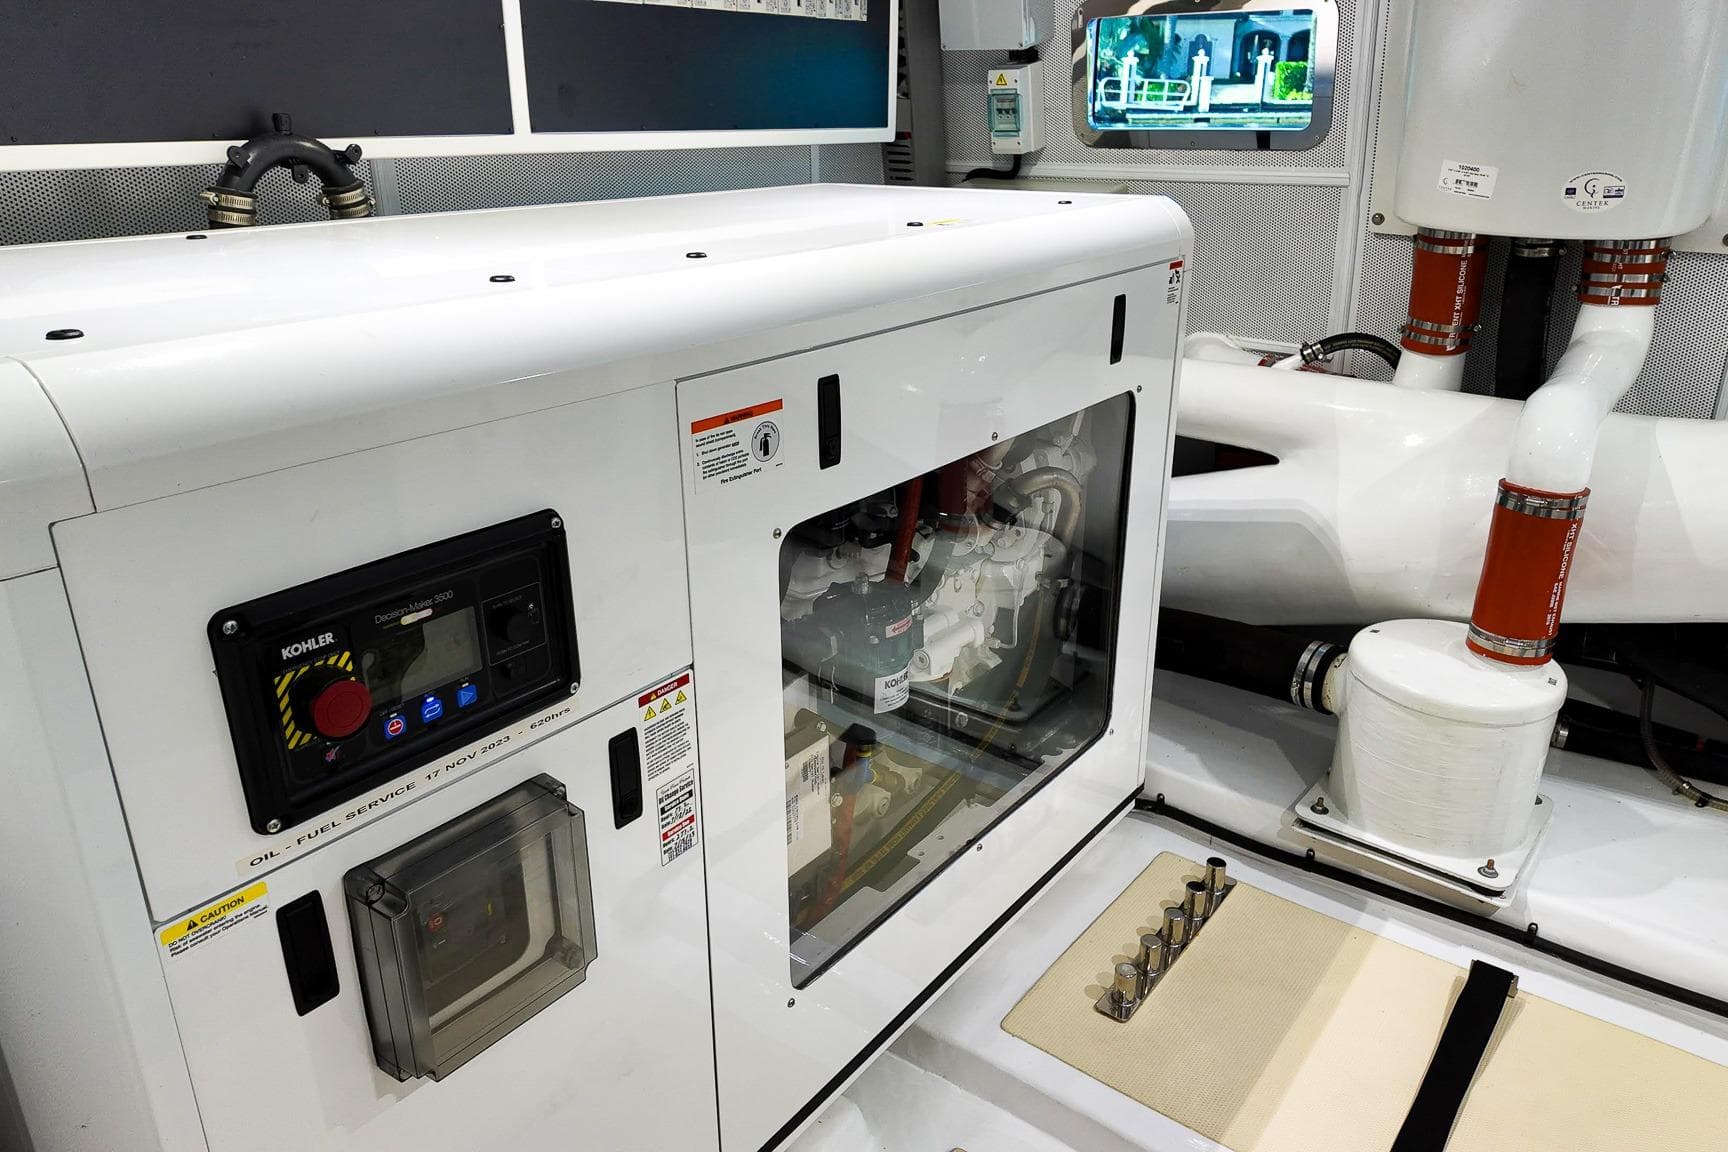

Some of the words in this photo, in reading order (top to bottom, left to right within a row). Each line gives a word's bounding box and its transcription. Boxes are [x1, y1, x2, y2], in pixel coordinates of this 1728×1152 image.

[1457, 260, 1468, 294] SILICONE
[729, 470, 752, 482] Extinguisher
[1559, 541, 1572, 579] SILICONE
[434, 590, 454, 603] 3500
[281, 632, 335, 660] KOHLER
[657, 682, 677, 696] DANGER
[250, 850, 280, 868] OIL
[297, 820, 341, 846] FUEL
[345, 781, 417, 821] SERVICE
[424, 769, 441, 782] 17
[445, 752, 479, 772] NOV
[480, 736, 511, 754] 2023
[530, 707, 571, 730] 620hrs
[680, 781, 693, 792] Service
[200, 896, 244, 923] CAUTION
[178, 934, 190, 942] NOT
